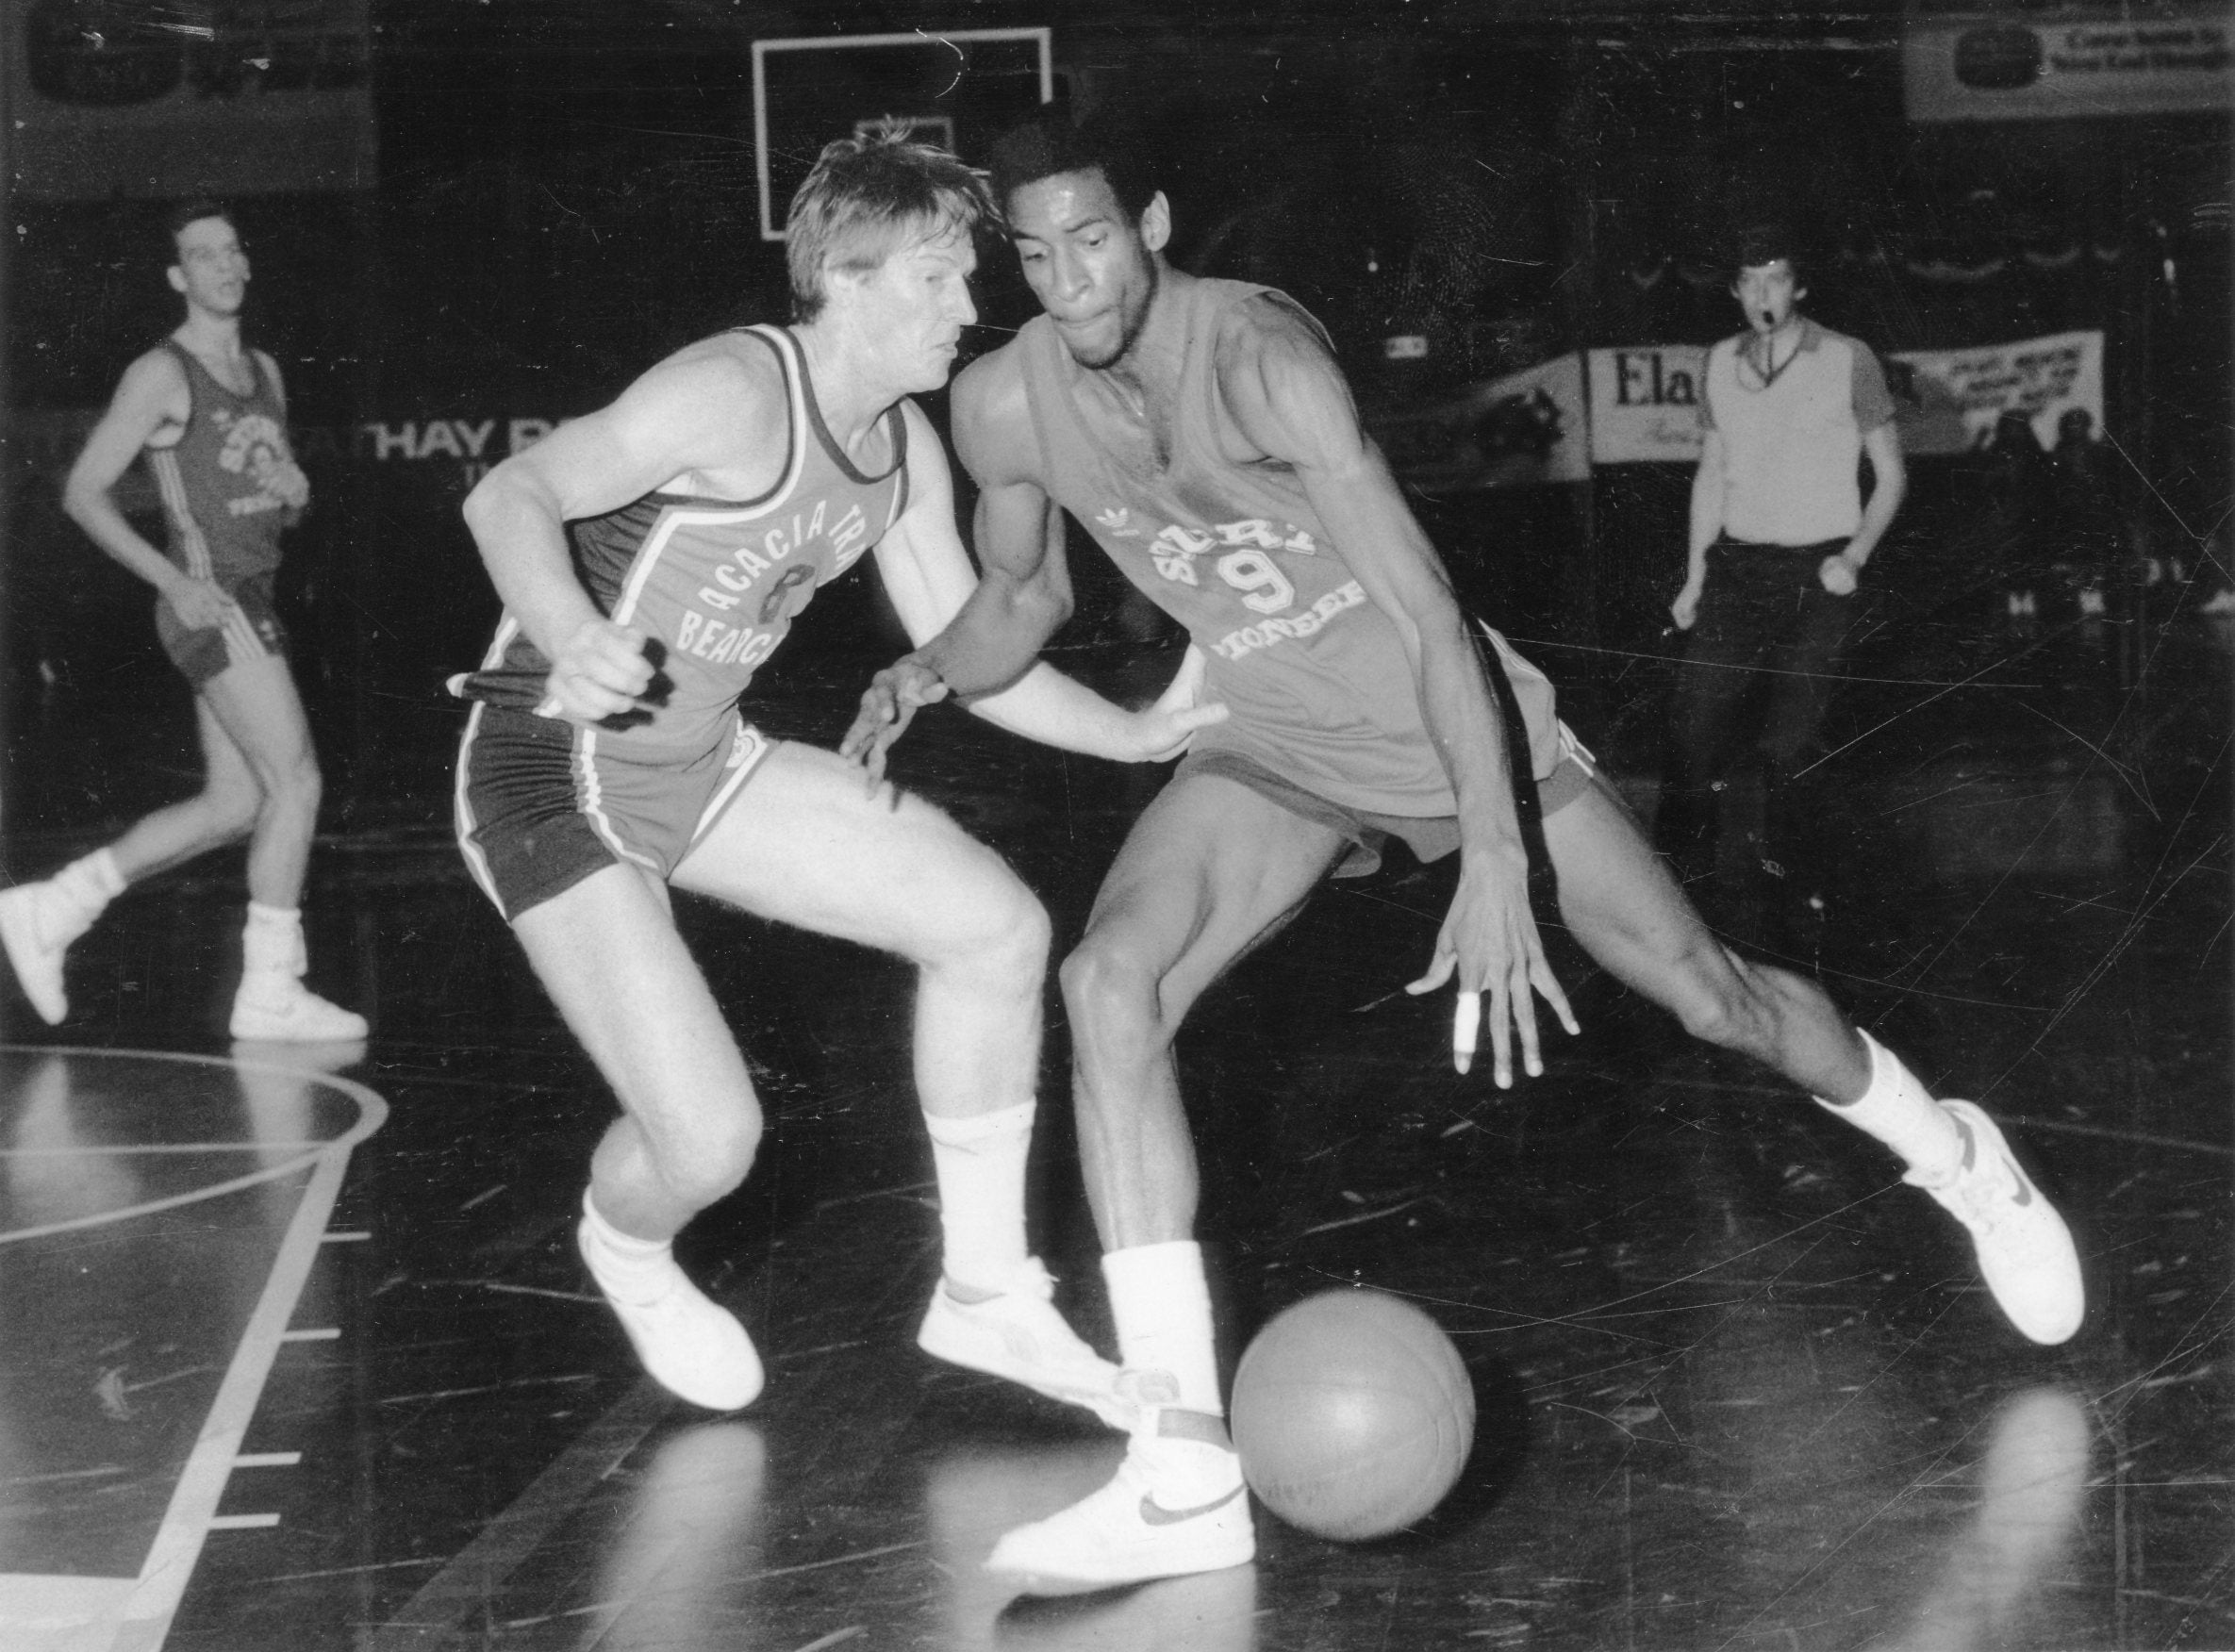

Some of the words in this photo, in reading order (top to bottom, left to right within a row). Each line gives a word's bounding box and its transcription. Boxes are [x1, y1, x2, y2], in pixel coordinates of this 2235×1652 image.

[1614, 350, 1699, 406] Ela
[697, 500, 828, 611] ACACIA
[822, 503, 869, 579] TRA
[1217, 549, 1295, 615] 9
